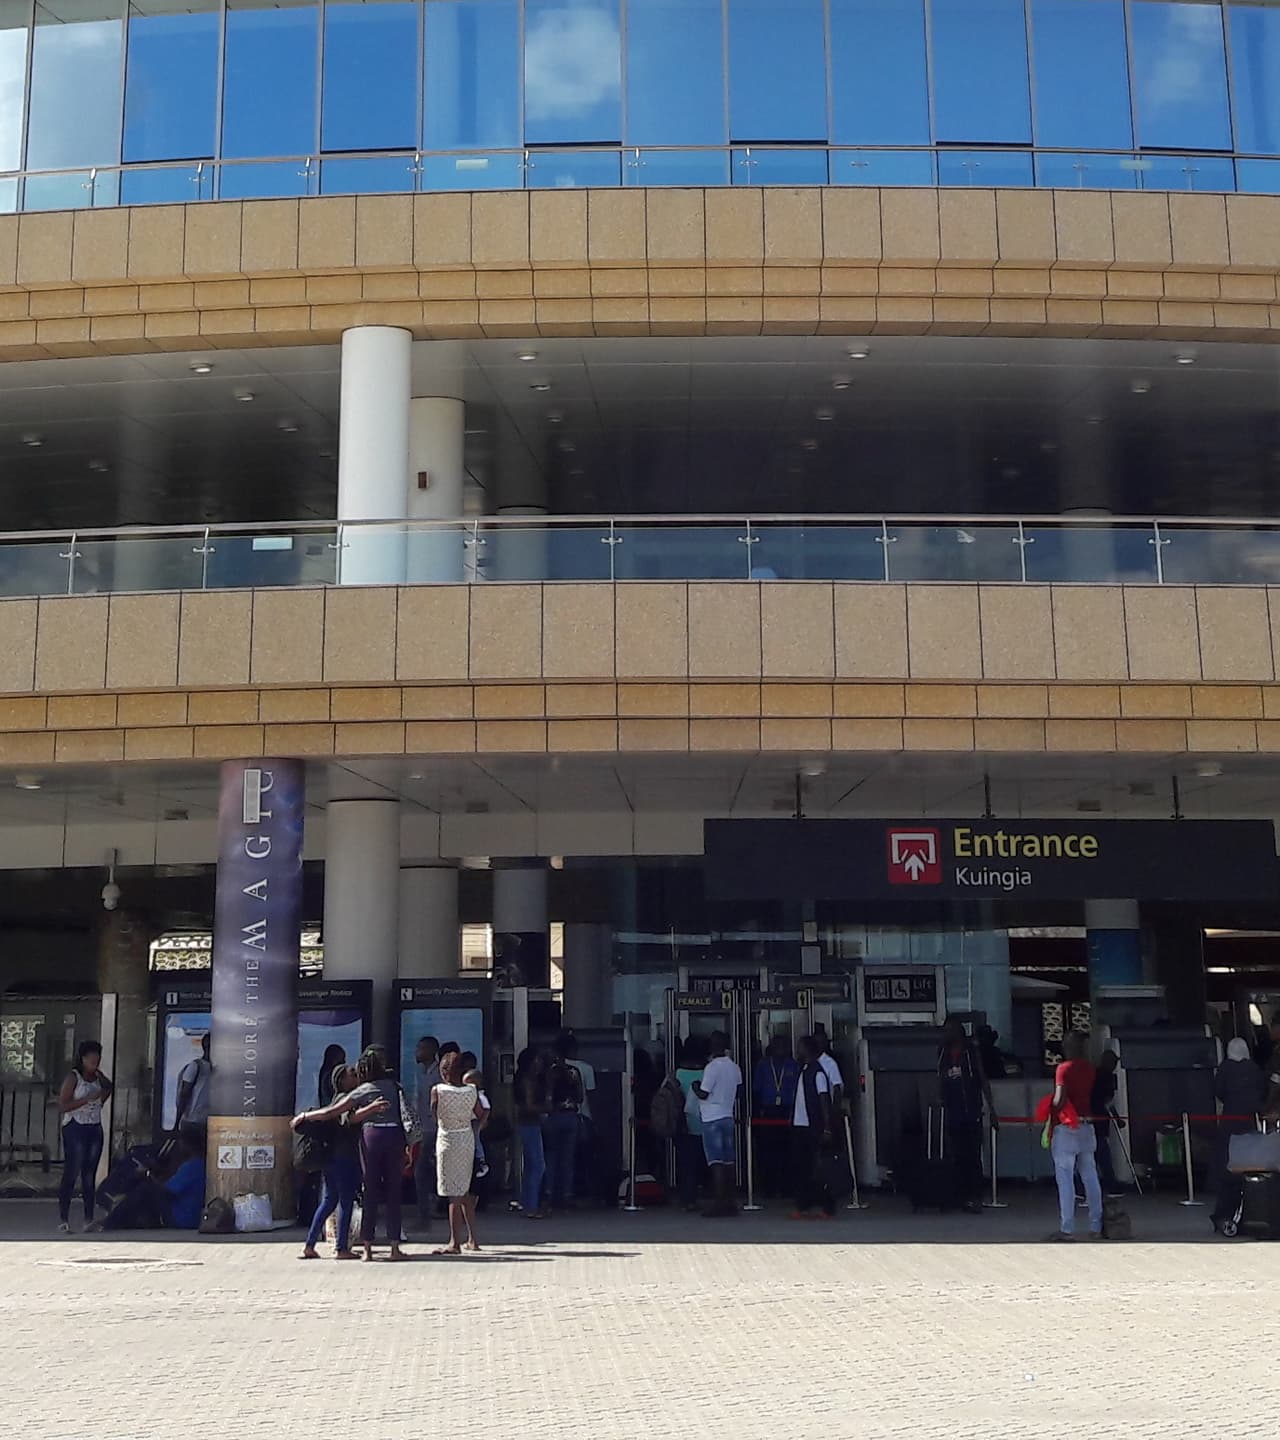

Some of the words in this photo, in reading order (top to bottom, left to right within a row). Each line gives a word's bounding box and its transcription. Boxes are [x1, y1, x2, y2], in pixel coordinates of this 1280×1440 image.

[953, 827, 1099, 858] Entrance
[955, 866, 1032, 891] Kuingia
[246, 959, 259, 1003] THE
[677, 997, 712, 1006] FEMALE
[758, 997, 783, 1005] MALE
[243, 1016, 258, 1121] EXPLORE
